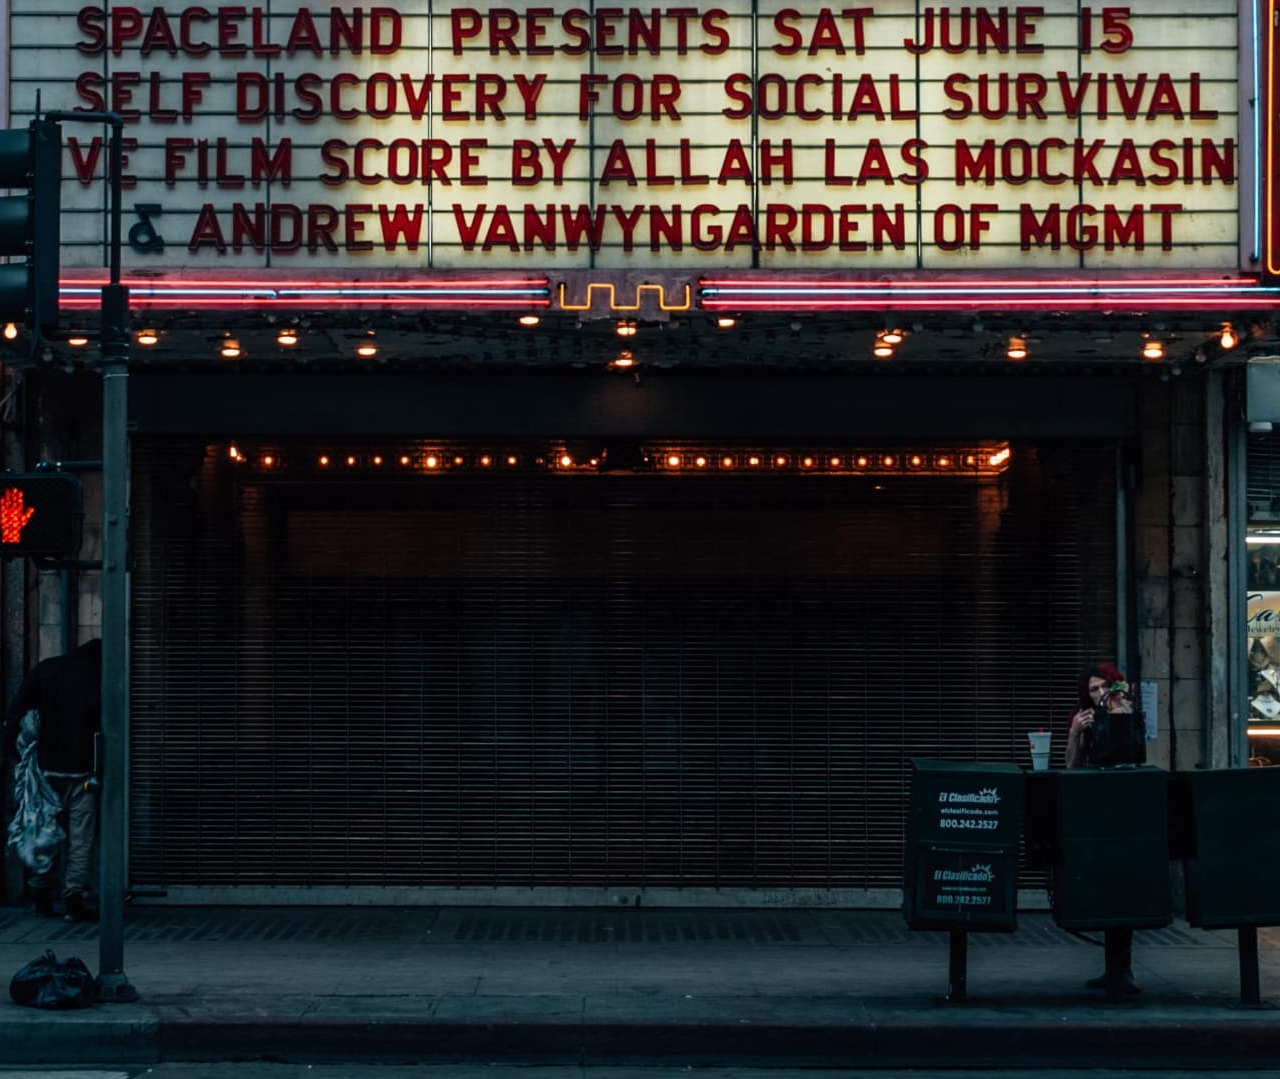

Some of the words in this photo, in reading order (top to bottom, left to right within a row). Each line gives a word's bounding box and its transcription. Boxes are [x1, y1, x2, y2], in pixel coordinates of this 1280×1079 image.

[75, 6, 403, 55] SPACELAND
[450, 7, 731, 56] PRESENTS
[771, 7, 874, 55] SAT
[903, 7, 1045, 55] JUNE
[1080, 7, 1134, 54] 15
[73, 71, 210, 120] SELF
[236, 72, 547, 122] DISCOVERY
[579, 73, 682, 121] FOR
[722, 73, 919, 121] SOCIAL
[943, 71, 1219, 120] SURVIVAL
[67, 136, 138, 187] VE
[165, 137, 292, 188] FILM
[321, 138, 488, 187] SCORE
[511, 138, 576, 186] BY
[600, 138, 793, 186] ALLAH
[824, 138, 929, 186] LAS
[955, 137, 1235, 186] MOCKASIN
[128, 203, 165, 254] &
[188, 202, 424, 255] ANDREW
[452, 203, 905, 252] VANWYNGARDEN
[933, 203, 999, 251] OF
[1020, 203, 1183, 251] MGMT
[939, 792, 948, 802] El
[949, 792, 997, 804] Clasificado
[940, 819, 999, 830] 800.242.2527
[934, 870, 942, 880] El
[942, 870, 990, 881] Clasificado
